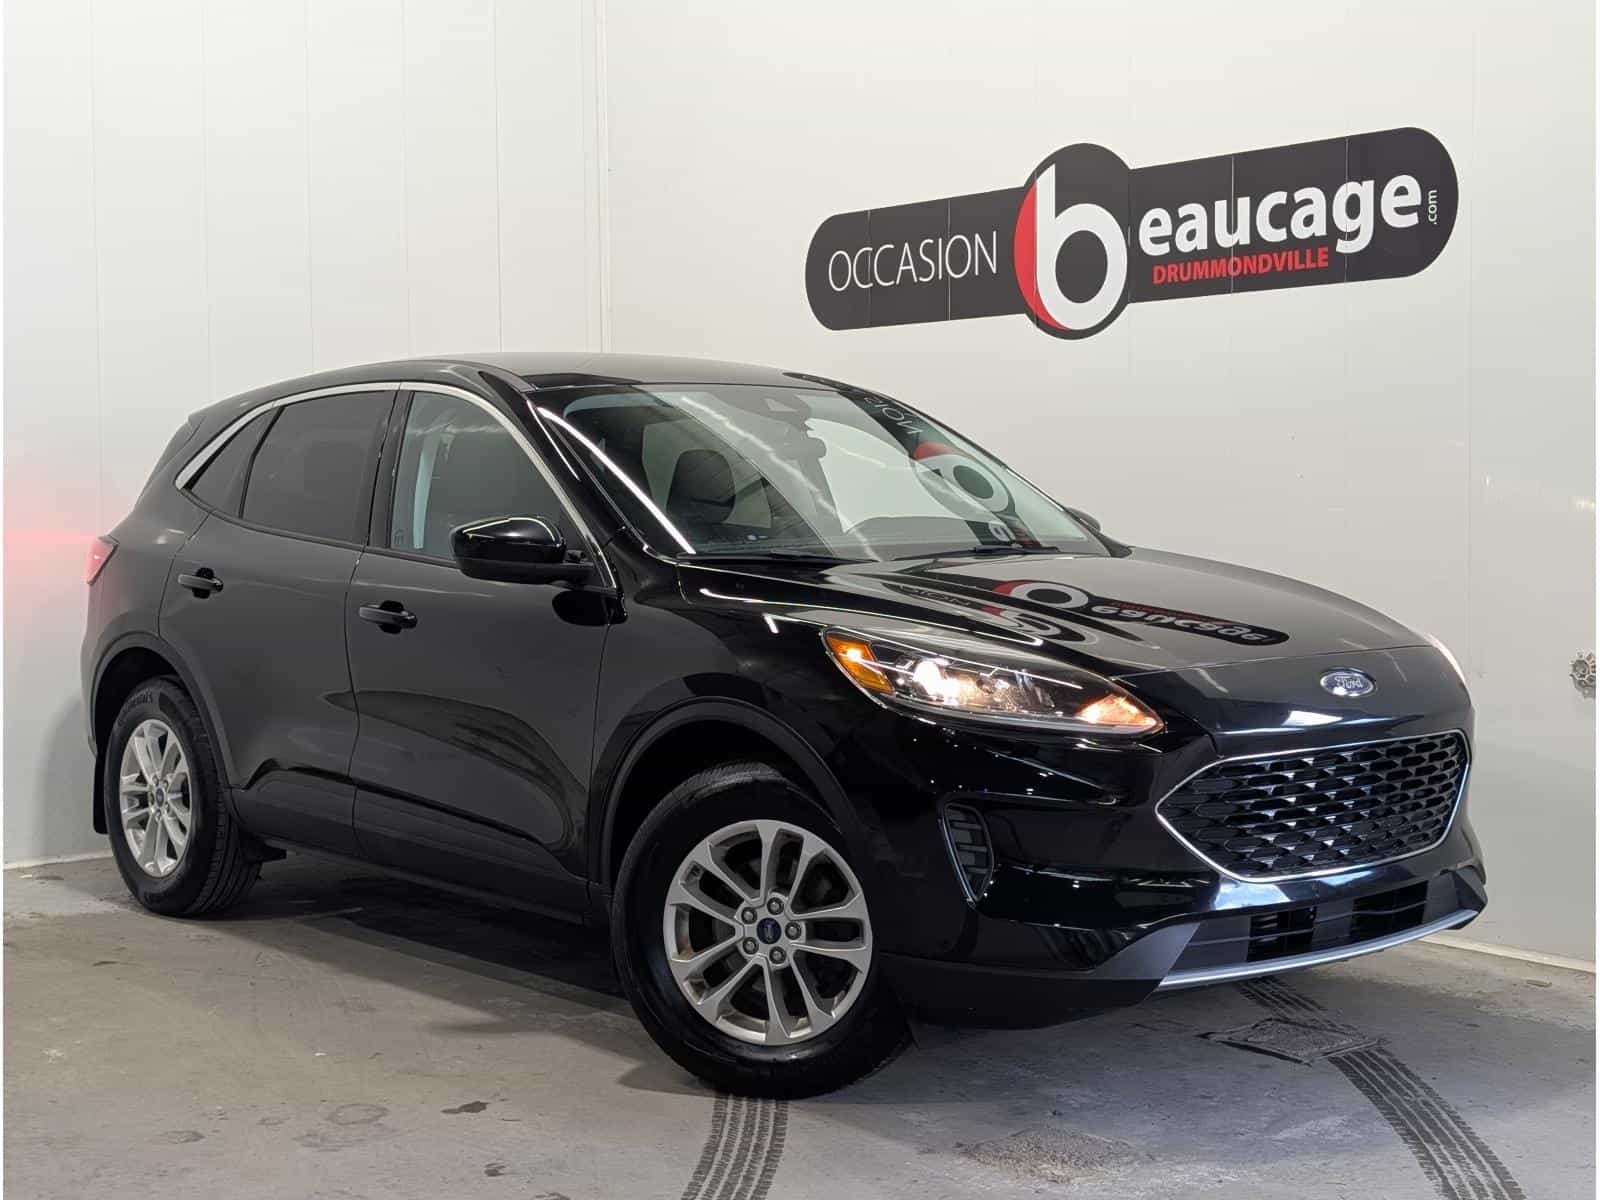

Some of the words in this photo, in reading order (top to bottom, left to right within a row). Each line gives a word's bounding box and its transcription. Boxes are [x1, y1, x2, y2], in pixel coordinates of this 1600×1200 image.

[828, 230, 997, 292] OCCASION
[1427, 189, 1438, 225] .com
[1152, 246, 1329, 284] DRUMMONDVILLE
